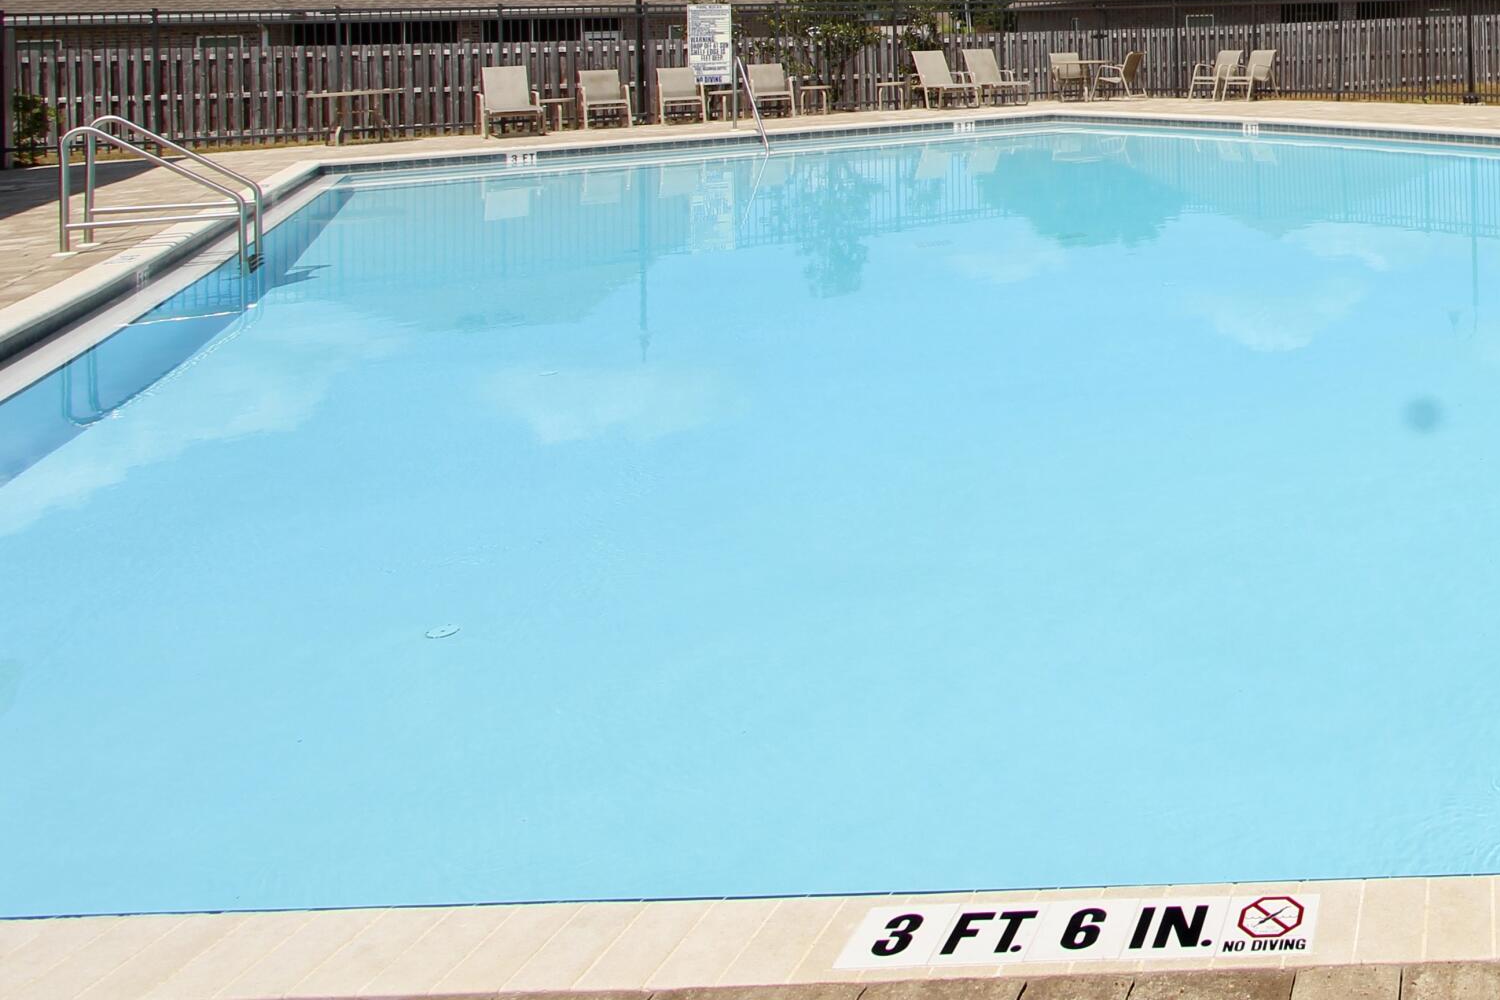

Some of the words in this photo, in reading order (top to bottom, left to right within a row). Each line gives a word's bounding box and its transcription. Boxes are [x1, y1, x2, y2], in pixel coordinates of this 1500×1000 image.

[511, 154, 518, 162] 3
[523, 153, 535, 163] FT
[871, 913, 924, 957] 3
[939, 910, 1039, 955] FT.
[1060, 907, 1107, 950] 6
[1128, 905, 1213, 949] IN.
[1222, 940, 1246, 952] NO
[1251, 938, 1306, 951] DIVING
